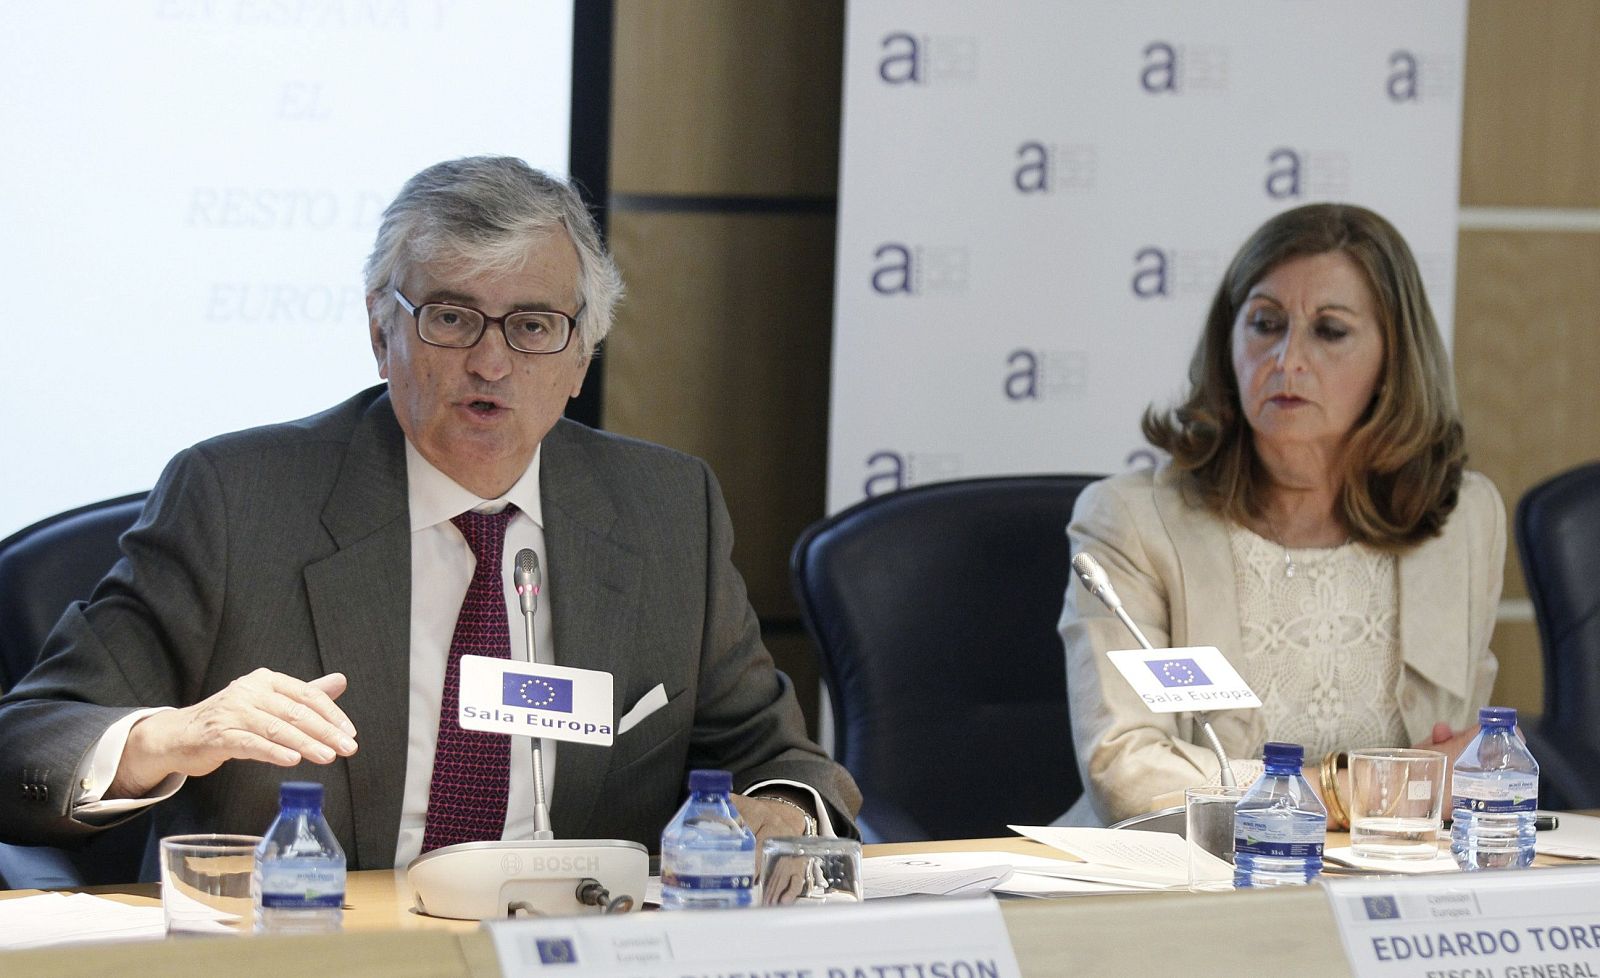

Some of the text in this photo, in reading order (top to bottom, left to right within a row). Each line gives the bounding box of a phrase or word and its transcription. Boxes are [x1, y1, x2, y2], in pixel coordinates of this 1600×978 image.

[274, 80, 334, 121] EL
[184, 186, 340, 231] RESTO
[204, 282, 366, 325] EUROP
[1142, 689, 1253, 704] Sala Europa
[463, 706, 611, 735] Sala Europa
[532, 856, 600, 872] BOSCH
[1370, 929, 1521, 961] EDUARDO
[1503, 962, 1597, 978] GENERAL
